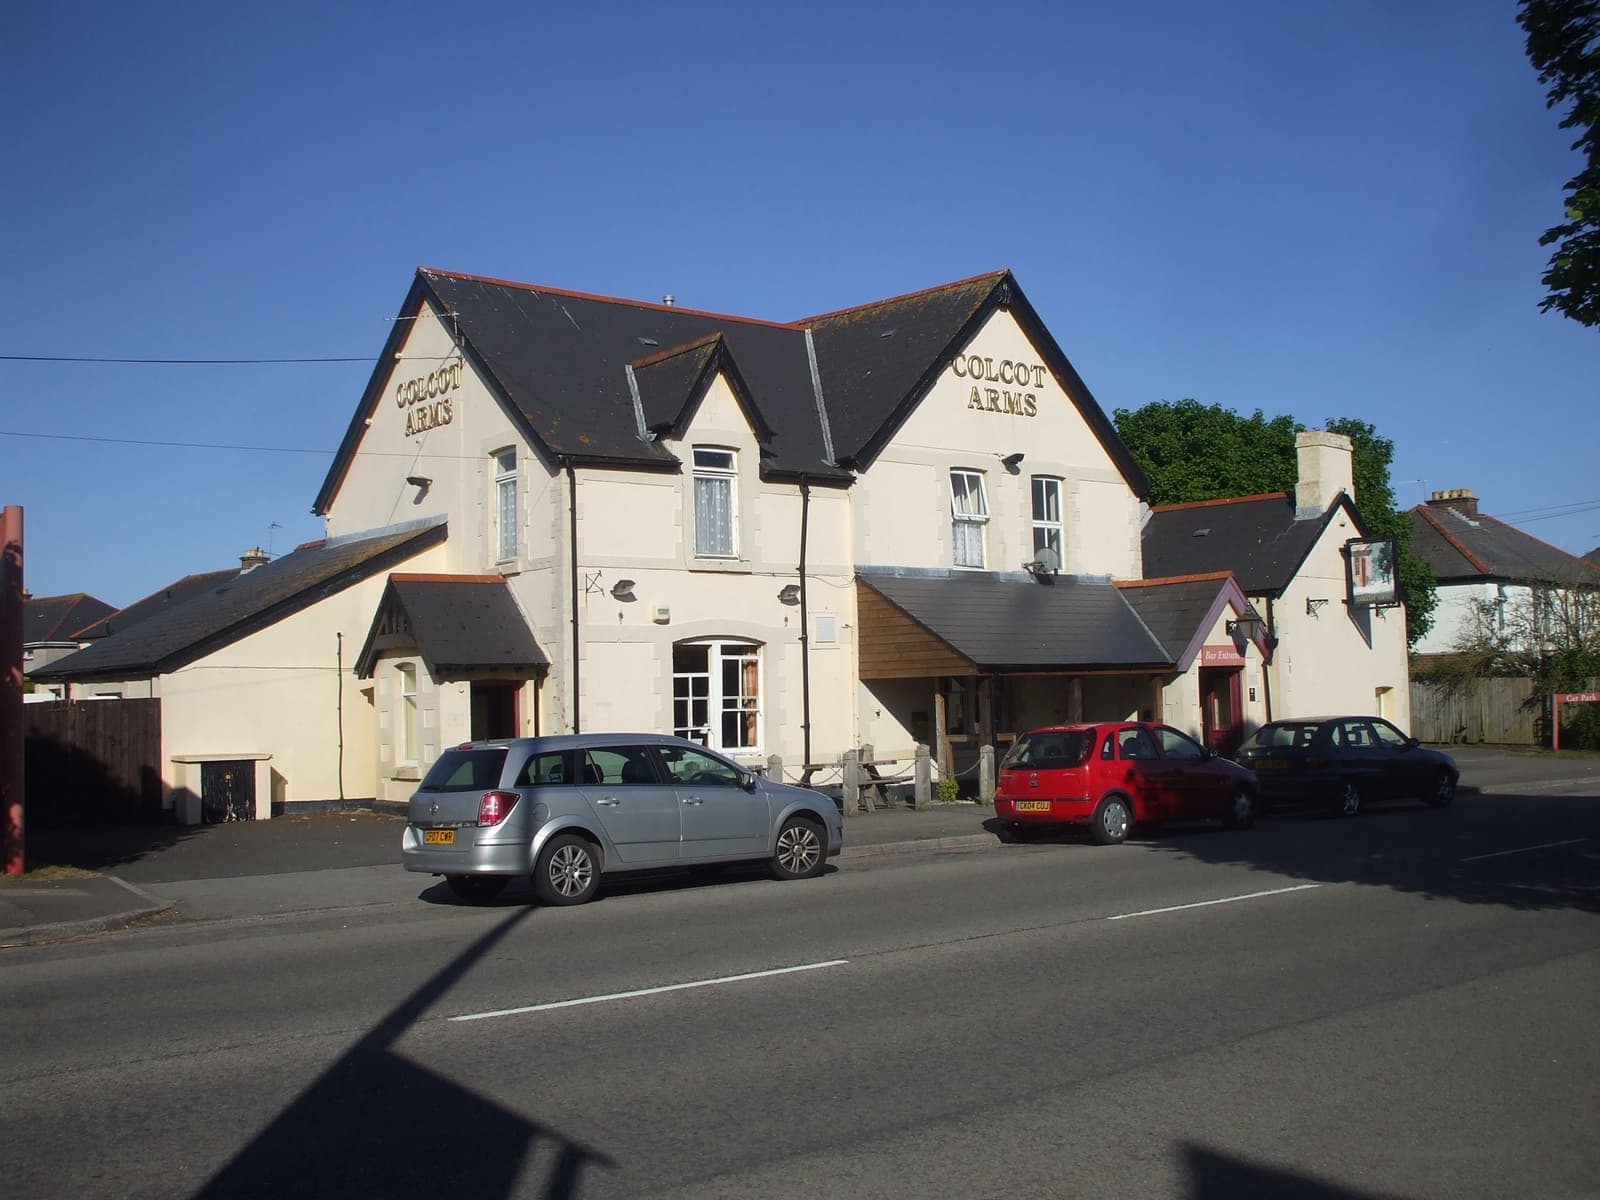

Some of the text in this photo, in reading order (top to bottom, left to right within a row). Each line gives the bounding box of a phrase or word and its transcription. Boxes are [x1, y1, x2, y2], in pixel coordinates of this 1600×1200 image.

[397, 363, 461, 408] COLCOT
[952, 353, 1046, 388] COLCOT
[405, 398, 453, 437] ARMS
[968, 386, 1037, 417] ARMS
[1205, 650, 1216, 660] Bar
[1566, 693, 1596, 702] Car Park
